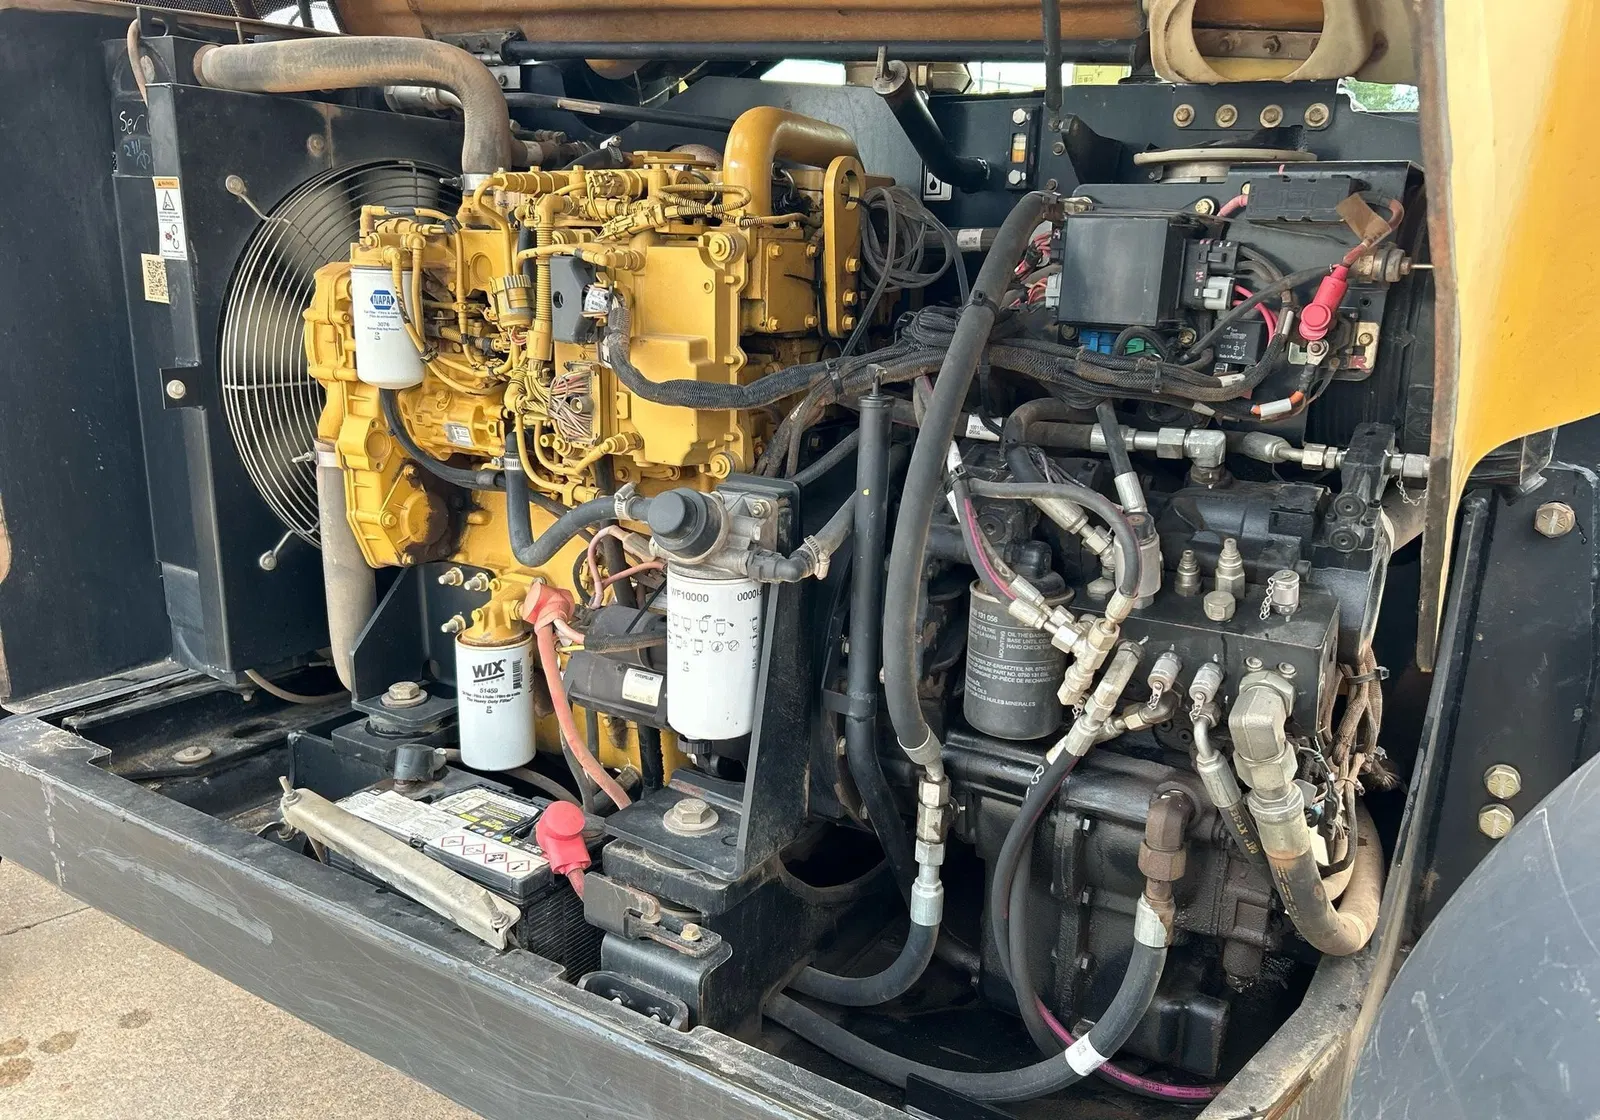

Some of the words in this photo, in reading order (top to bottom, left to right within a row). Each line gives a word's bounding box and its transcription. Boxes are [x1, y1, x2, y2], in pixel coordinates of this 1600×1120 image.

[373, 295, 391, 305] NAPA
[670, 587, 709, 603] WF10000
[987, 614, 998, 623] 056
[472, 659, 504, 678] WIX
